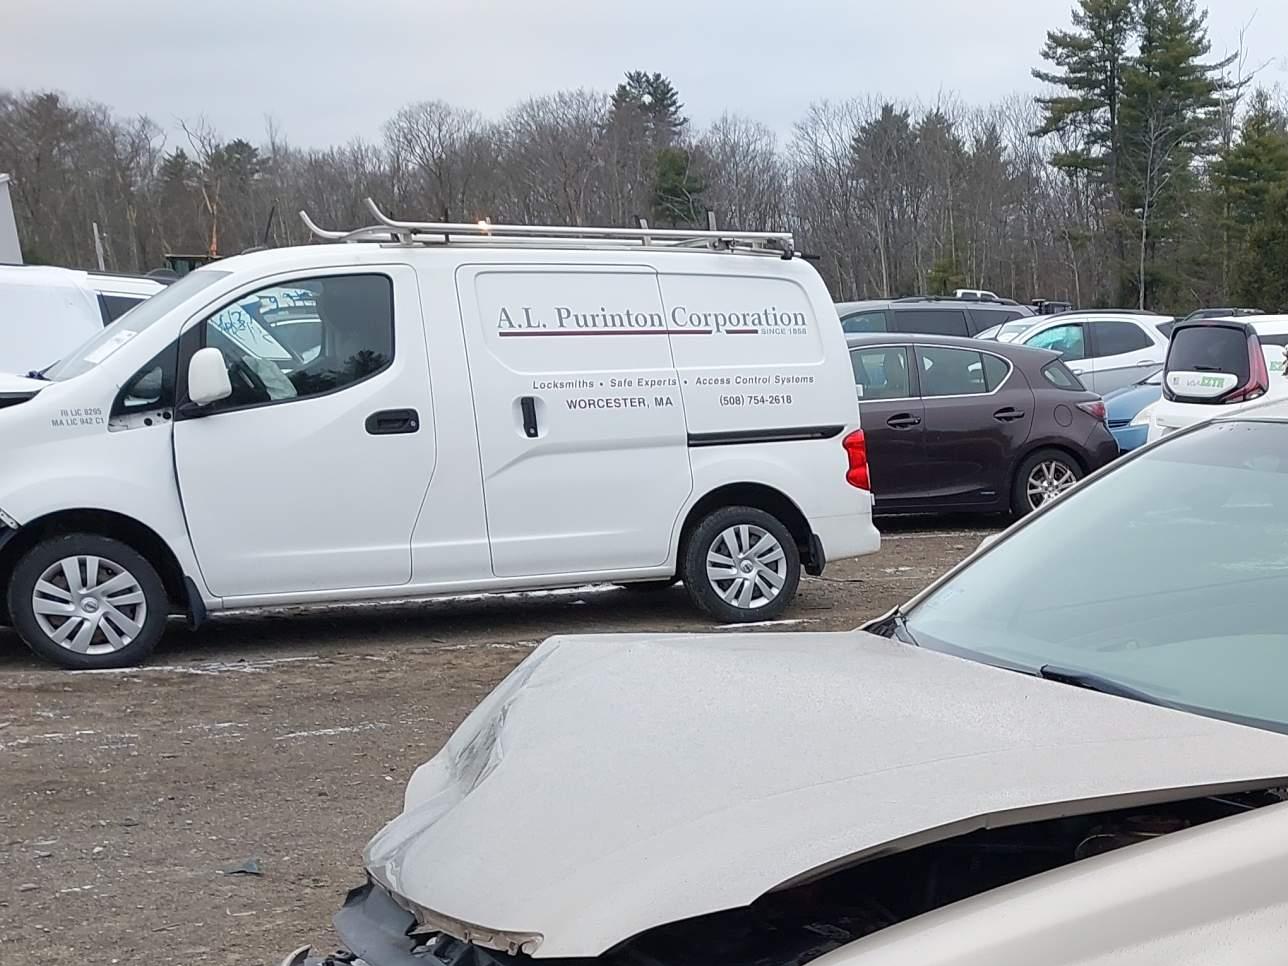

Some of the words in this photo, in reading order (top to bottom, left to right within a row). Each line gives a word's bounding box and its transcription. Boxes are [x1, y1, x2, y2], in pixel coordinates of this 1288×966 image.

[497, 306, 547, 329] A.L.
[554, 306, 665, 329] Purinton
[671, 306, 807, 333] Corporation
[532, 379, 594, 390] Locksmiths
[610, 378, 633, 388] Safe
[637, 377, 677, 388] Experts
[695, 377, 731, 385] Access
[734, 375, 771, 385] Control
[774, 375, 814, 386] Systems
[566, 397, 650, 409] WORCESTER,
[654, 396, 674, 407] MA
[719, 394, 745, 406] (508)
[747, 394, 793, 405] 754-2618
